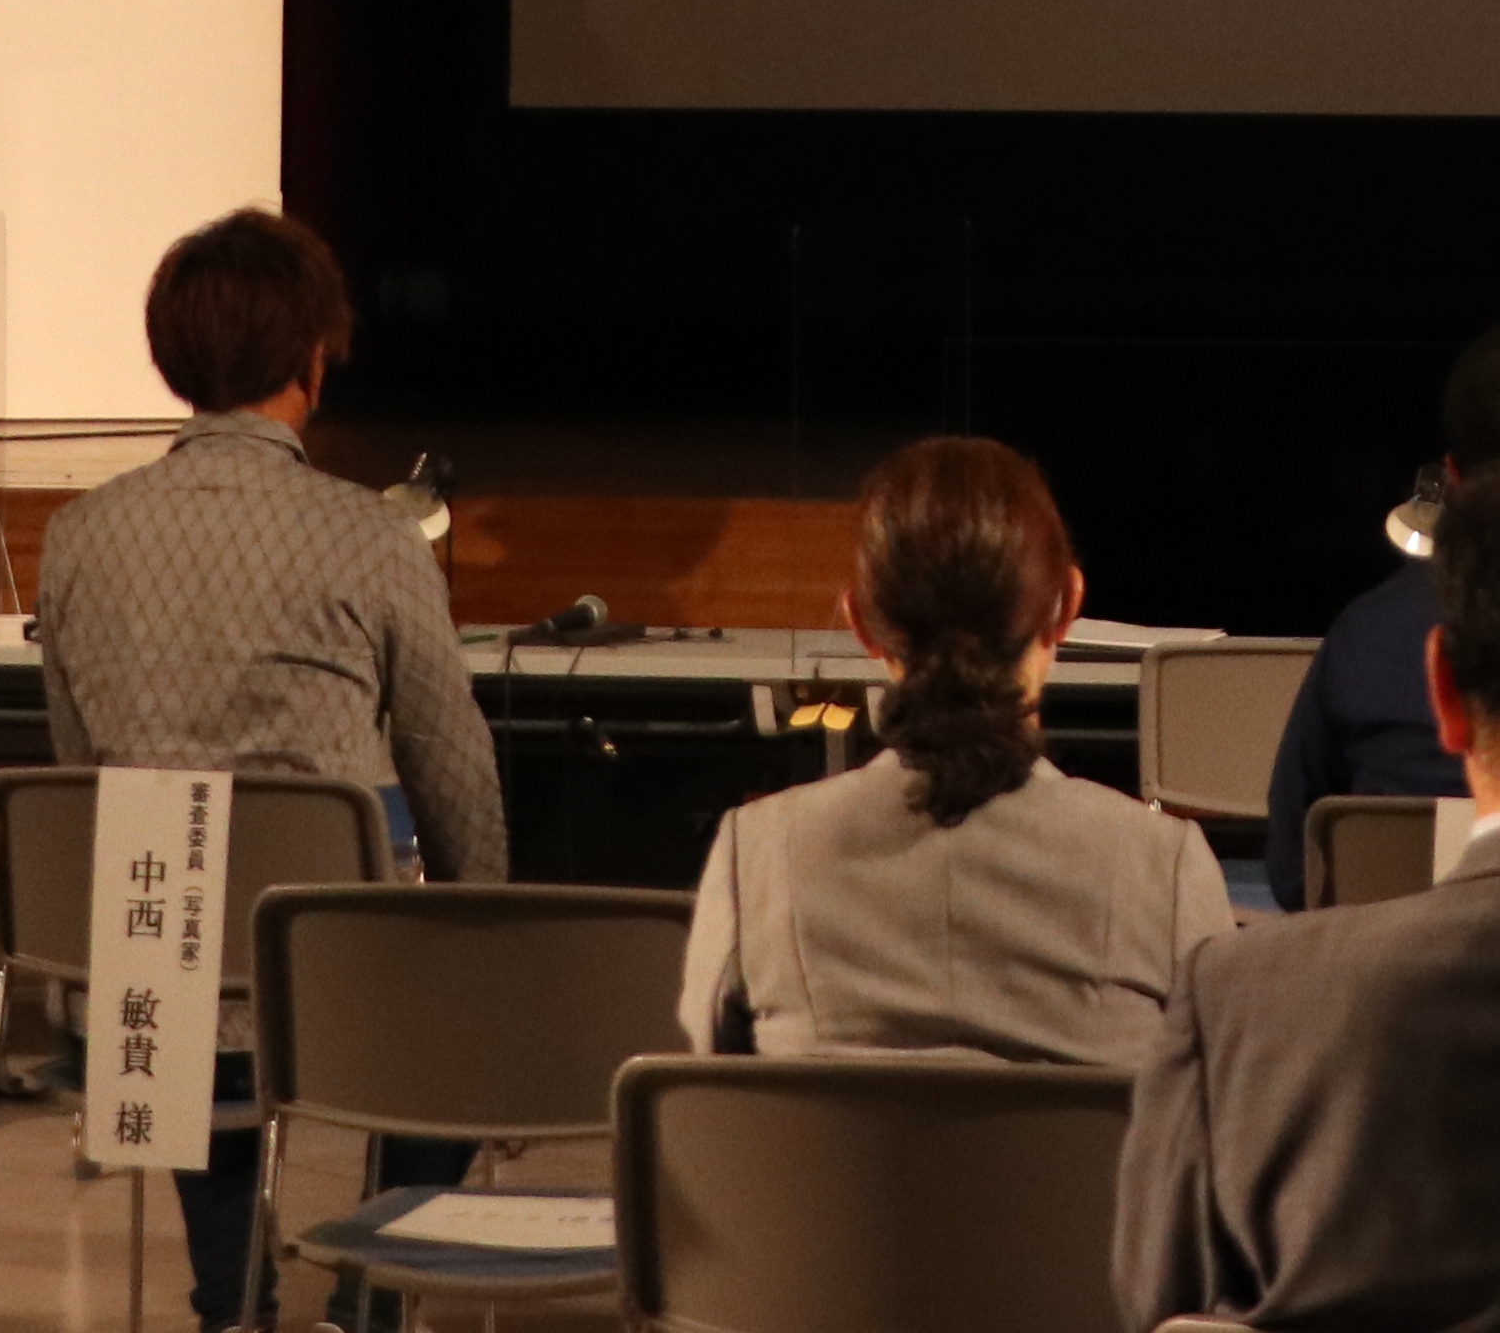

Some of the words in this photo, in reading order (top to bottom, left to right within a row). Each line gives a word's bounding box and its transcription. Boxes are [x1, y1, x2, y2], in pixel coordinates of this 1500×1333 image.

[126, 851, 167, 940] 中西
[119, 987, 161, 1078] 敏貴
[114, 1101, 154, 1145] 様
